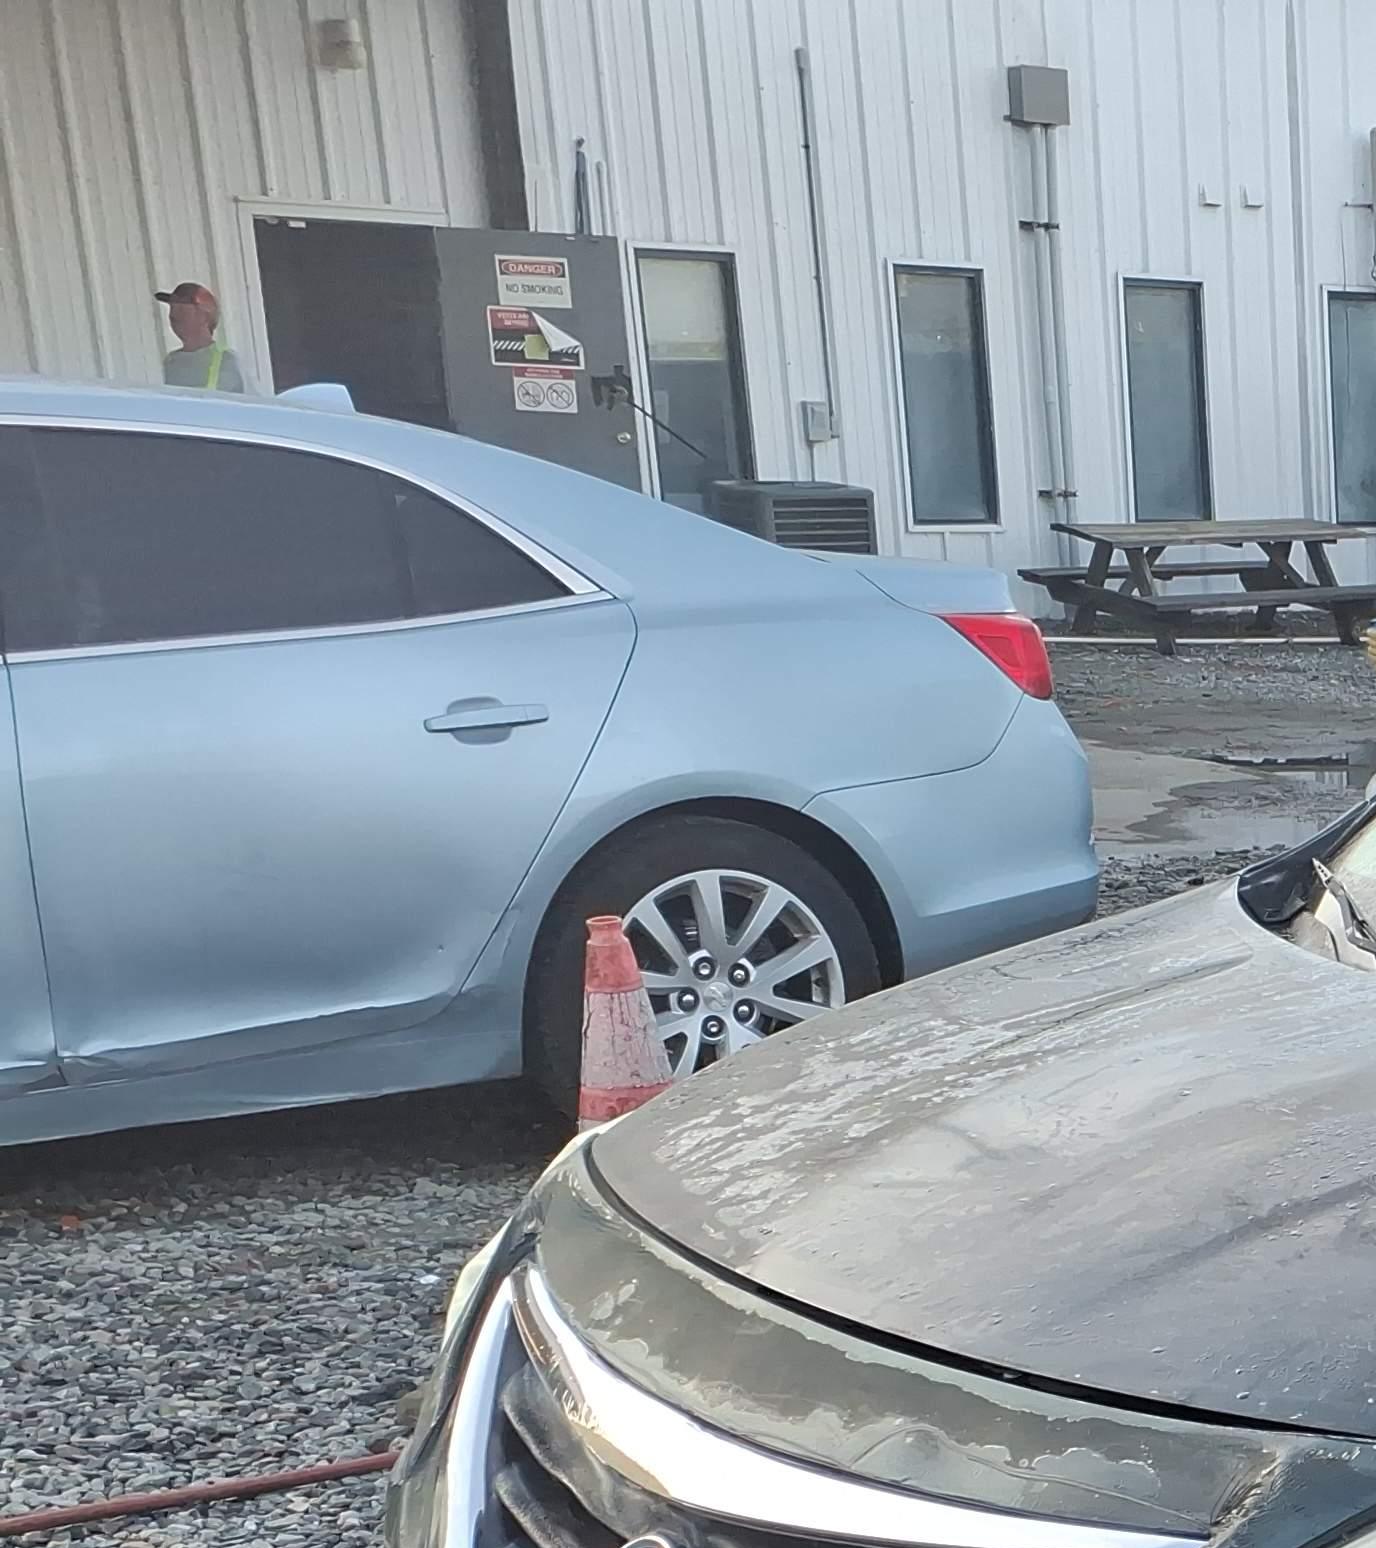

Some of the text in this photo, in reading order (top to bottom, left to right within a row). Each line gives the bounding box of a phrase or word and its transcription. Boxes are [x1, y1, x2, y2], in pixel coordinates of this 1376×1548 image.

[508, 263, 557, 275] DANGER
[505, 283, 564, 296] NO SMOKING
